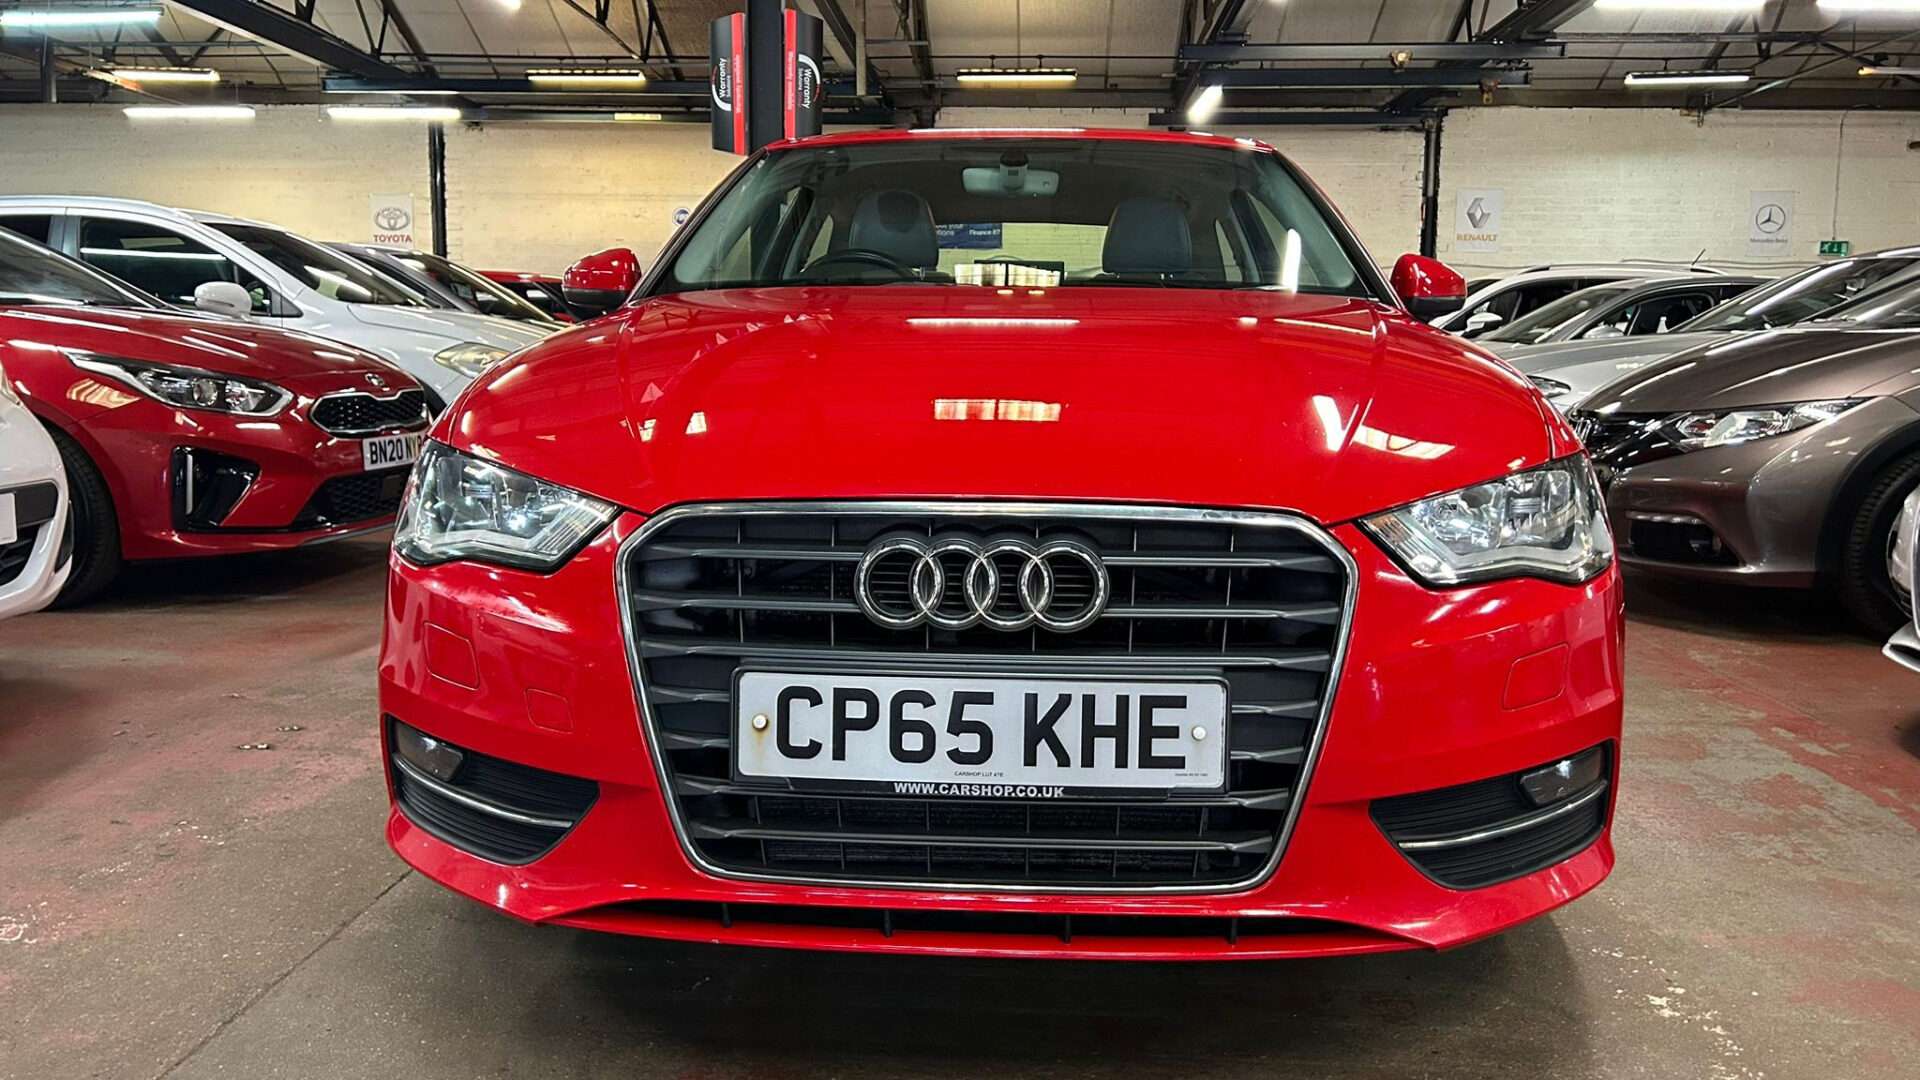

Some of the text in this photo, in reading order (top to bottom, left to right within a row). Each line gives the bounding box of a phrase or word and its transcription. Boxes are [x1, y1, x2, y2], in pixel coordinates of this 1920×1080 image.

[719, 57, 728, 98] Warranty
[802, 68, 811, 109] Warranty
[373, 234, 412, 243] TOYOTA
[1456, 233, 1497, 241] RENAULT
[369, 438, 404, 465] BN20
[776, 685, 1188, 769] CP65 KHE
[894, 782, 1065, 798] WWW.CARSHOP.CO.UK
